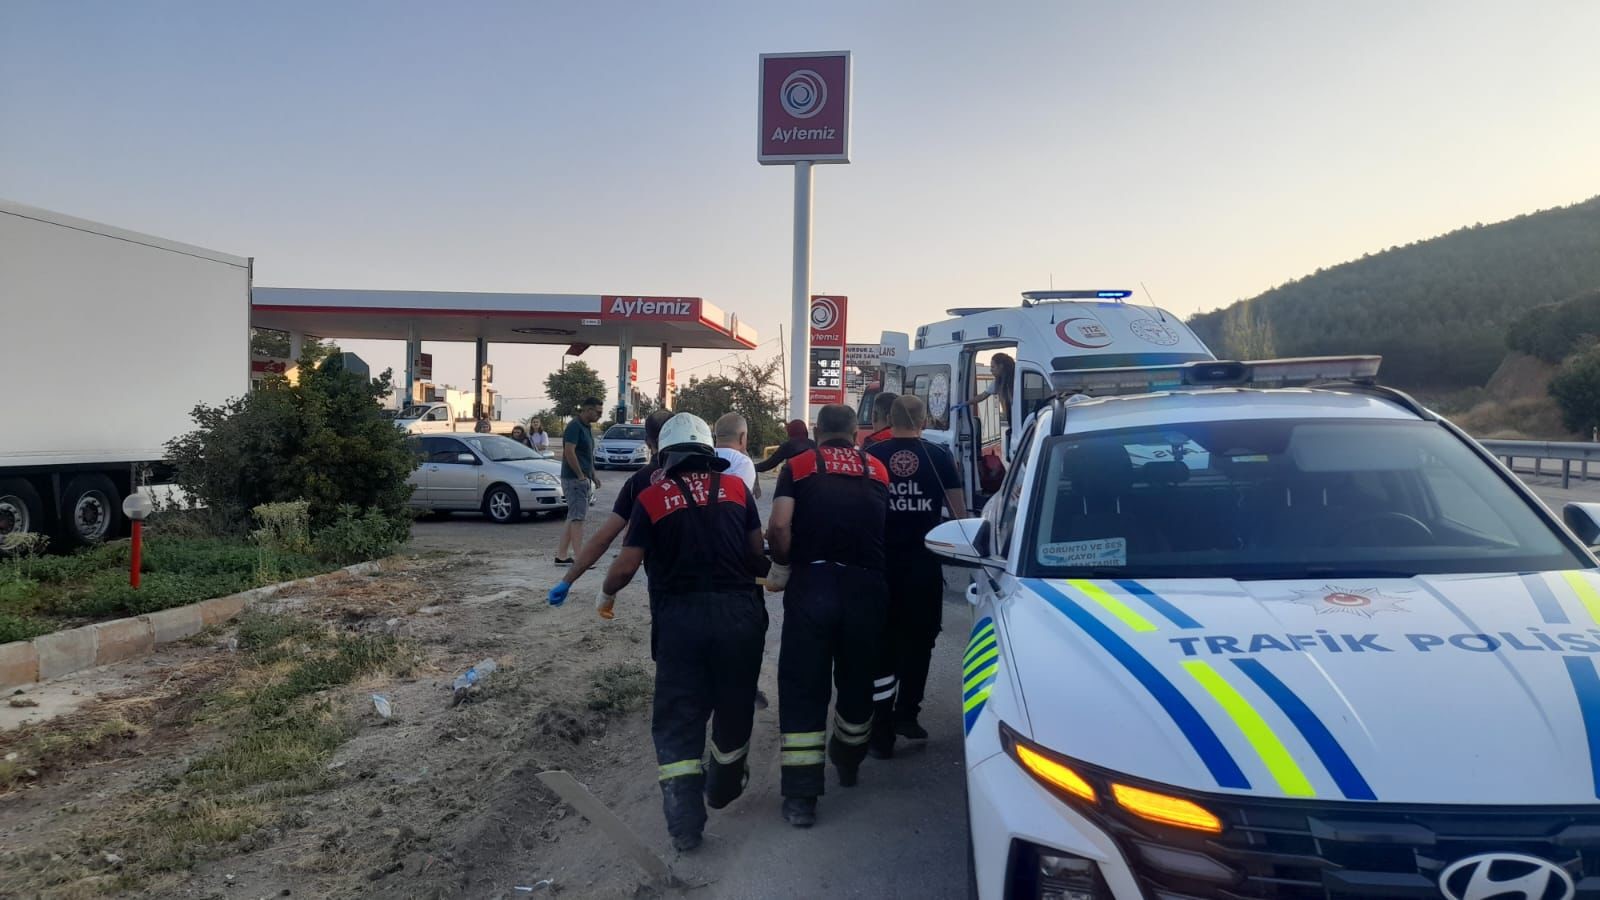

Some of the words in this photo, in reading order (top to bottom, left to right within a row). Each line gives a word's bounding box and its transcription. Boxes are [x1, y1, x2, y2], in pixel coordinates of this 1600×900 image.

[771, 126, 836, 143] Aytemiz
[610, 297, 692, 317] Aytemiz
[1082, 325, 1101, 333] 112
[811, 333, 840, 342] ytemiz
[888, 479, 923, 495] ACİL
[889, 495, 933, 512] AĞLIK
[1090, 543, 1103, 551] VE
[1169, 629, 1396, 656] TRAFİK
